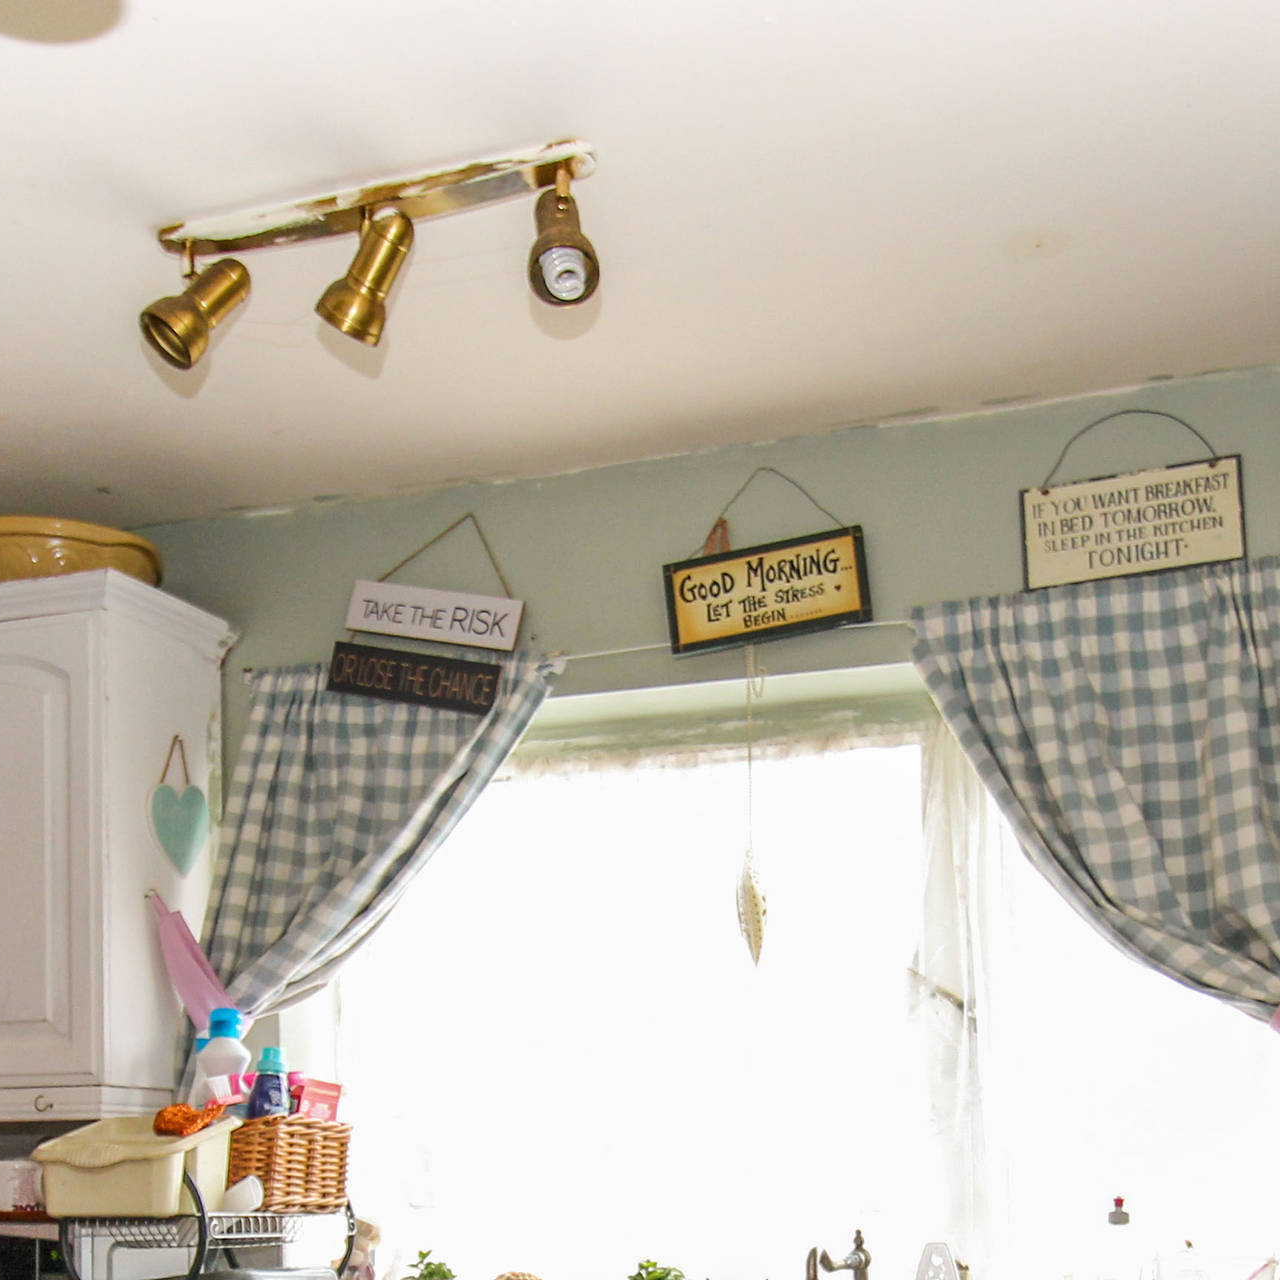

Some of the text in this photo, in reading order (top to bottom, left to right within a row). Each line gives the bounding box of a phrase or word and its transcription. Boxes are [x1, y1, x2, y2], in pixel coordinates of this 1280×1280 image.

[1032, 473, 1230, 520] IF YOU WANT BREAKFAST
[1037, 520, 1056, 538] IN
[1060, 516, 1094, 535] BED
[1043, 516, 1224, 553] SLEEP IN THE KITCHEN
[679, 572, 735, 604] GOOD
[706, 582, 825, 622] LET THE STRESS
[362, 599, 509, 638] TAKE THE RISK
[743, 608, 787, 629] BEGIN
[357, 655, 397, 690] LOSE
[399, 662, 429, 695] THE
[429, 667, 494, 706] CHANCE
